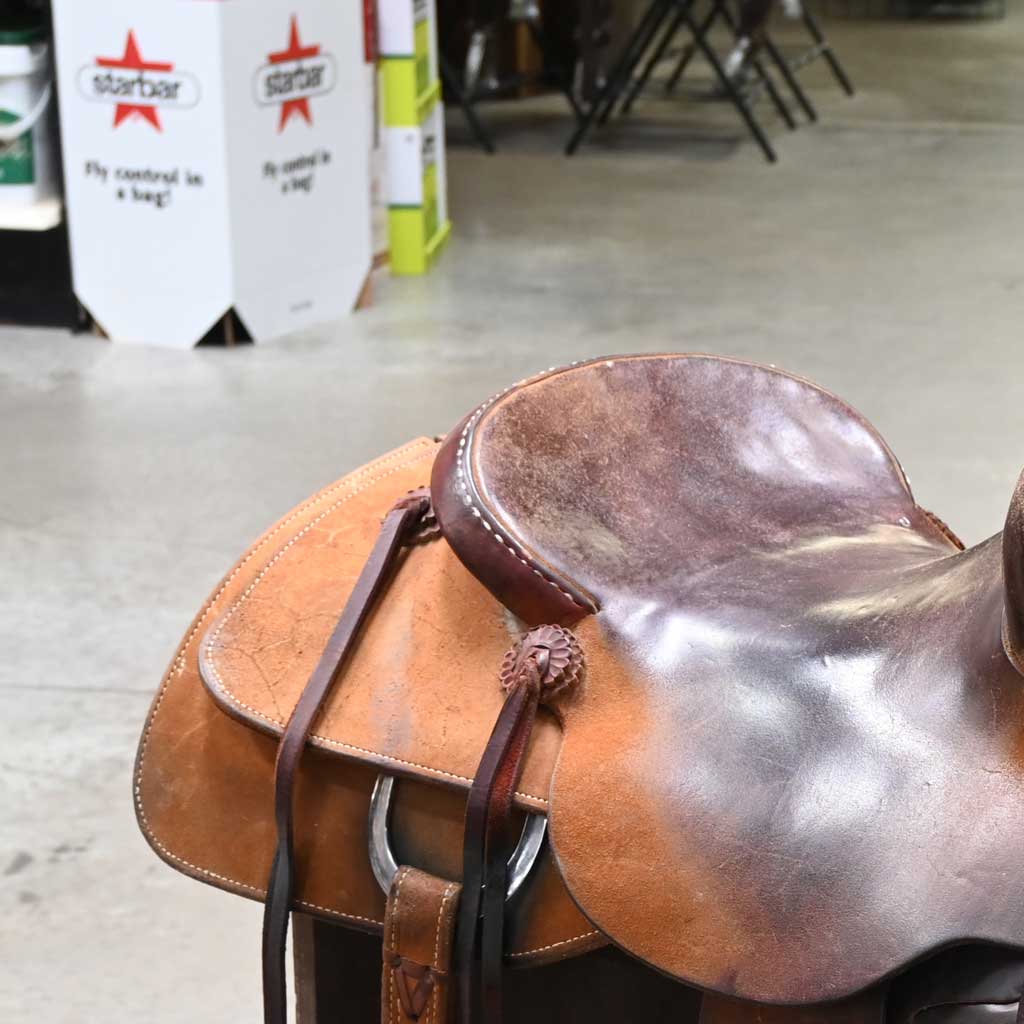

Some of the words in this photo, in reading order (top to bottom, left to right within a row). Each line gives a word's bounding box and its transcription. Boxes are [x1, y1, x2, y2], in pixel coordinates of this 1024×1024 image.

[92, 70, 182, 99] starbar
[264, 62, 325, 98] starbar
[85, 160, 108, 181] Fly
[115, 166, 179, 184] control
[186, 170, 203, 187] in
[116, 187, 124, 200] a
